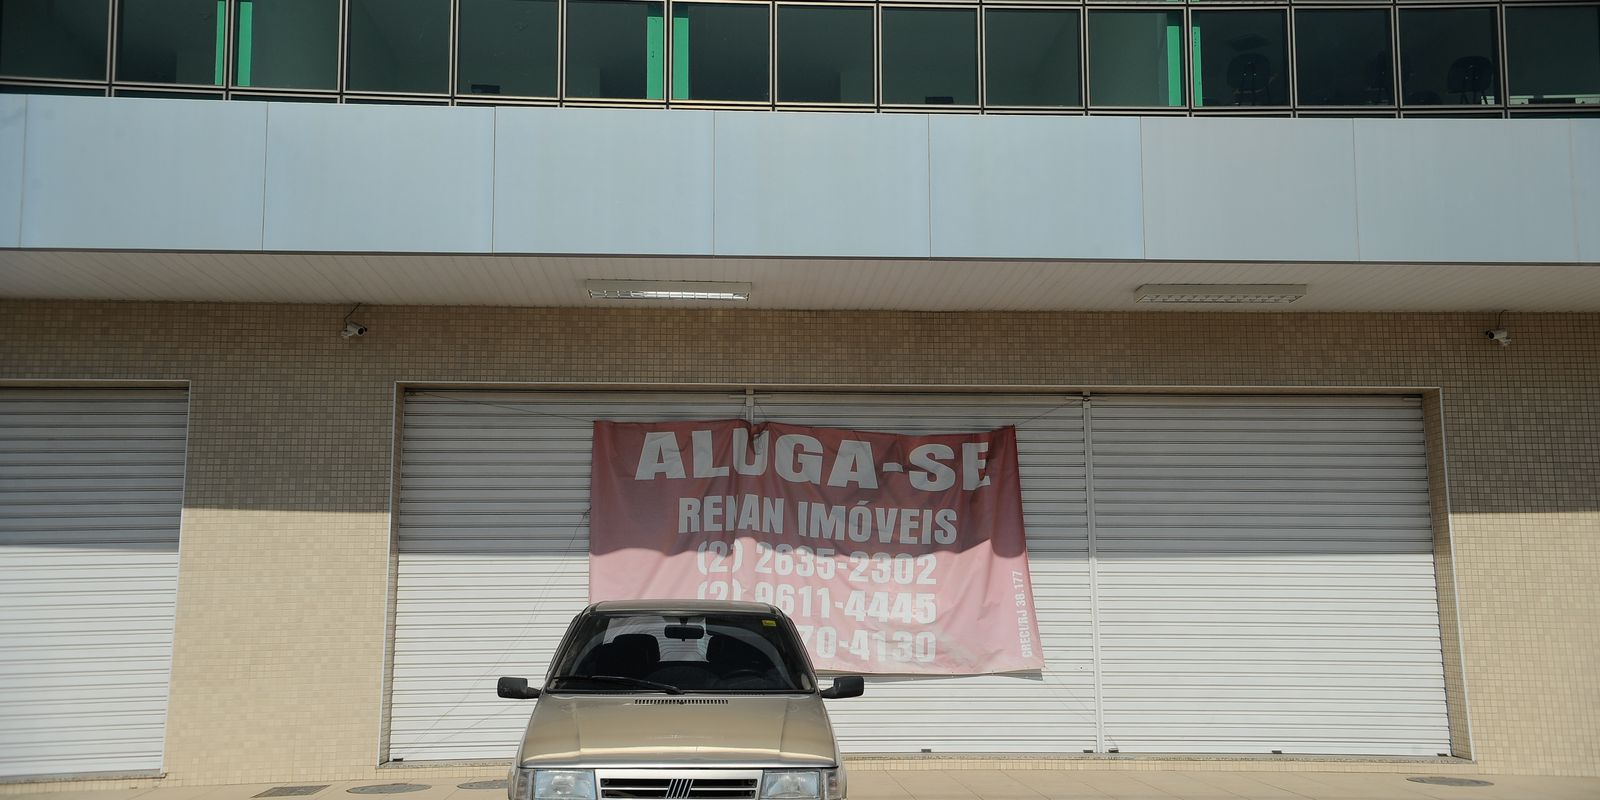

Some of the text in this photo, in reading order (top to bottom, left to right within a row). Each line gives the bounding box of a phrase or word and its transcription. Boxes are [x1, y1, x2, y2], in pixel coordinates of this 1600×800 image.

[634, 427, 991, 492] ALUGA-SE
[797, 500, 958, 545] IMÓVEIS
[754, 541, 937, 585] 2635-2302
[754, 581, 937, 625] 9611-4445
[795, 624, 937, 663] 70-4130
